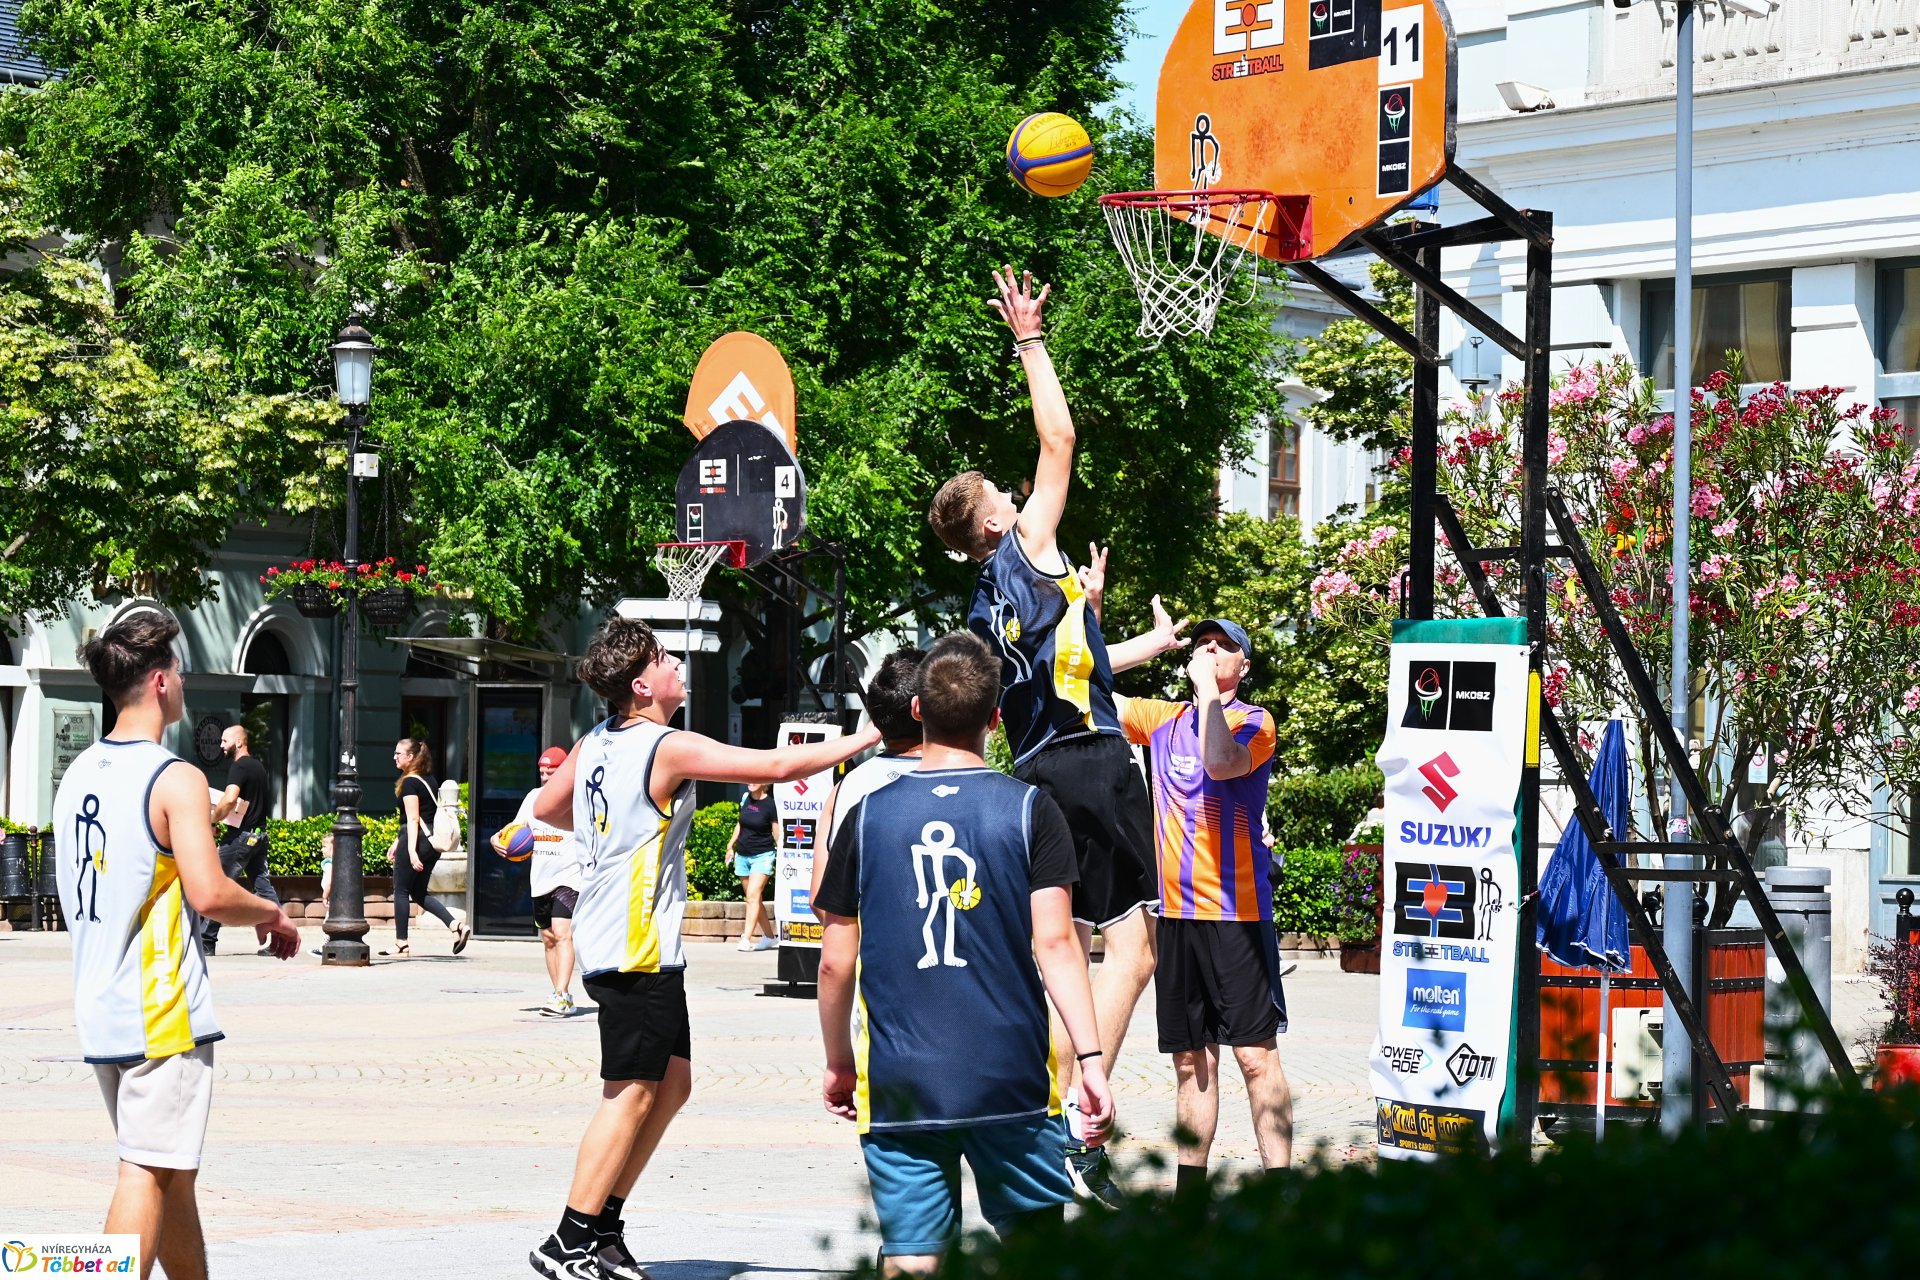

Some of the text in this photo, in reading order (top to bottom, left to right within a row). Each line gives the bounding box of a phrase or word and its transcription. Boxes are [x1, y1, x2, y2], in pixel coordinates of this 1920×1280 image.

[1383, 23, 1420, 67] 11
[1381, 162, 1407, 172] MKOSZ
[781, 473, 790, 490] 4
[1455, 690, 1491, 700] MKOSZ
[783, 801, 823, 811] SUZUKI
[1400, 820, 1492, 849] SUZUKI
[1413, 985, 1460, 1005] molten
[1410, 1004, 1420, 1013] For
[1392, 1059, 1420, 1074] ADE
[1456, 1053, 1498, 1081] TOTI
[1392, 1105, 1417, 1134] KING
[1419, 1115, 1435, 1135] OF
[1399, 1139, 1418, 1150] SPORTS
